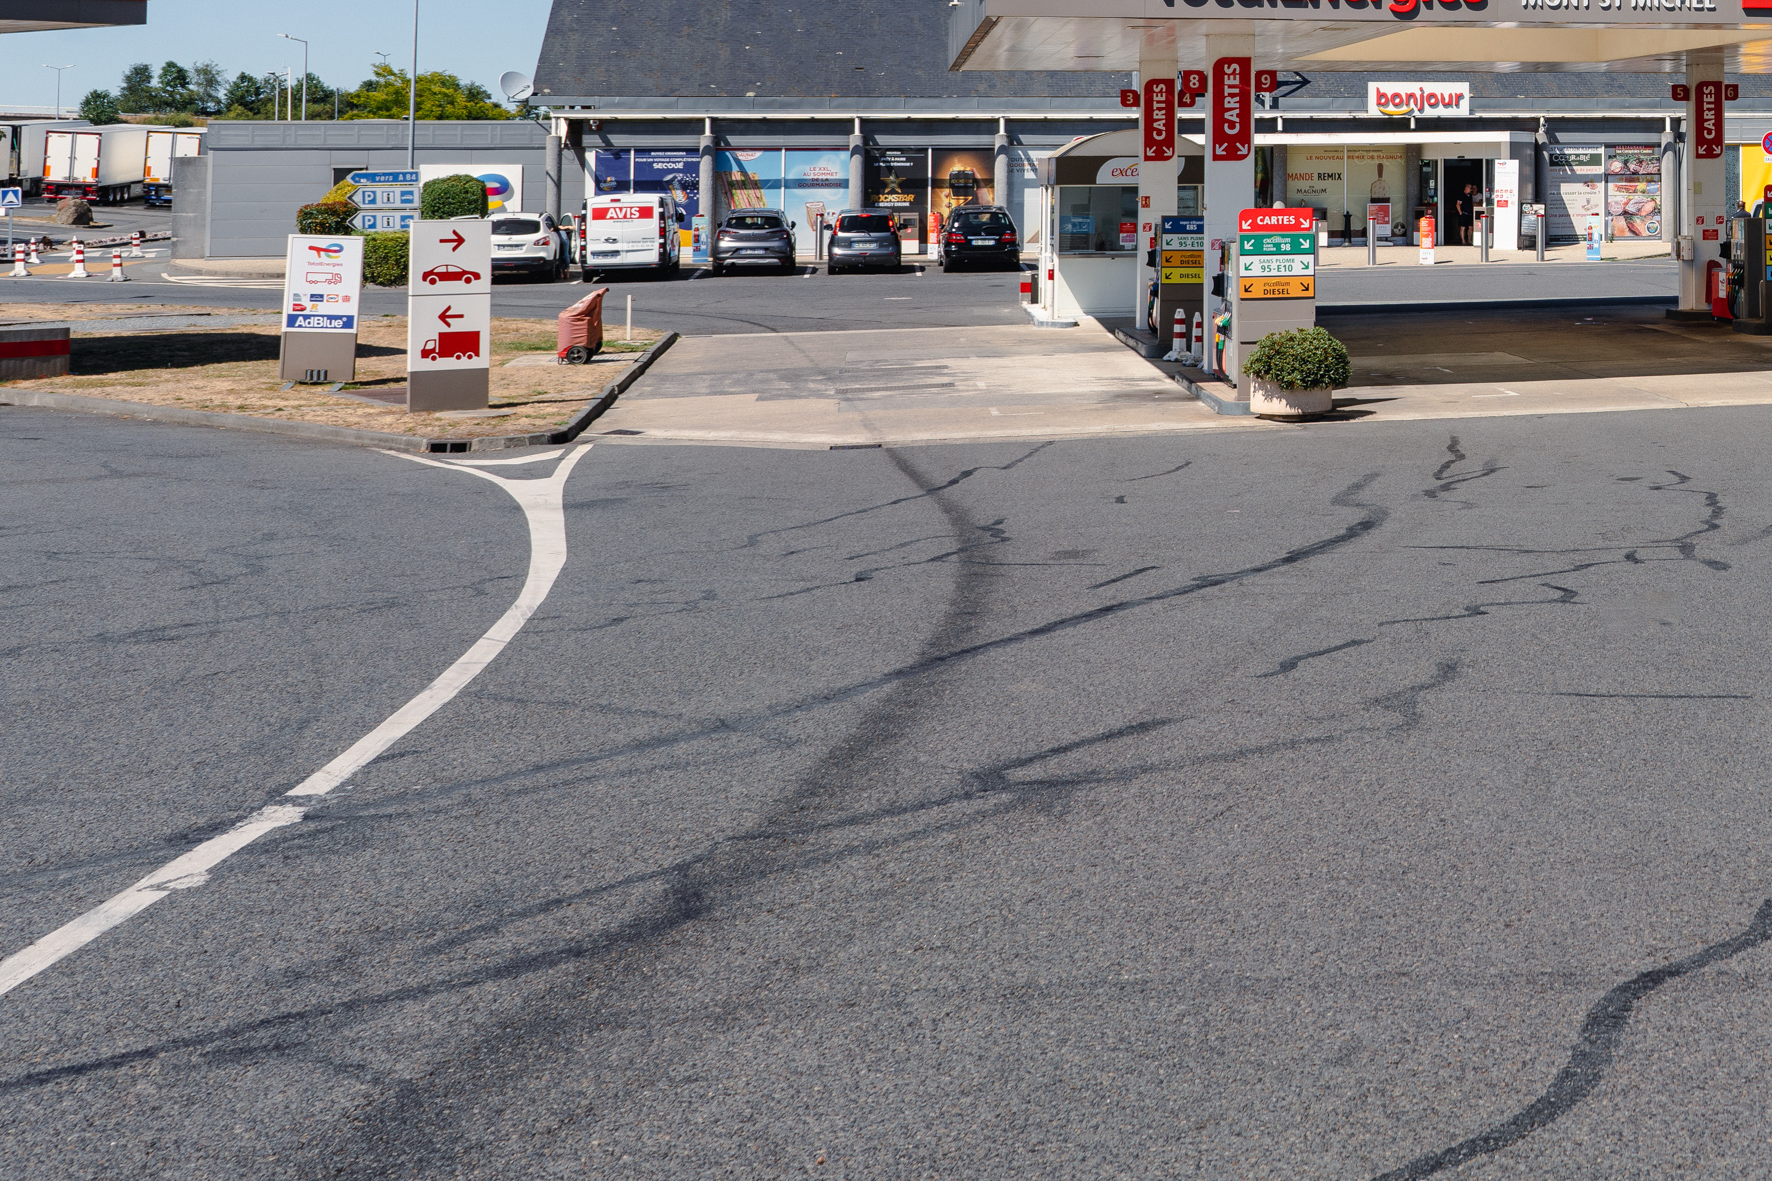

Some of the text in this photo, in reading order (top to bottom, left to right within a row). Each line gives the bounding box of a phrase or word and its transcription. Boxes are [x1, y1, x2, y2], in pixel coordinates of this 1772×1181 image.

[1189, 74, 1199, 88] 8
[1260, 74, 1271, 88] 9
[1676, 87, 1684, 98] 5
[1727, 87, 1734, 98] 6
[1125, 93, 1133, 104] 3
[1182, 93, 1191, 104] 4
[1223, 63, 1240, 135] CARTES
[1375, 86, 1464, 112] bonjour
[1152, 83, 1166, 141] CARTES
[1703, 85, 1715, 139] CARTES
[653, 161, 685, 169] SECOUÉ
[398, 173, 404, 181] A
[405, 173, 417, 181] 84
[1317, 172, 1342, 181] REMIX
[870, 193, 916, 202] ROCKSTAR
[605, 207, 640, 219] AVIS
[1256, 215, 1296, 225] CARTES
[1178, 240, 1204, 248] 95-E10
[1262, 235, 1291, 244] excellium
[1280, 243, 1291, 251] 98
[1260, 264, 1294, 273] 95-E10
